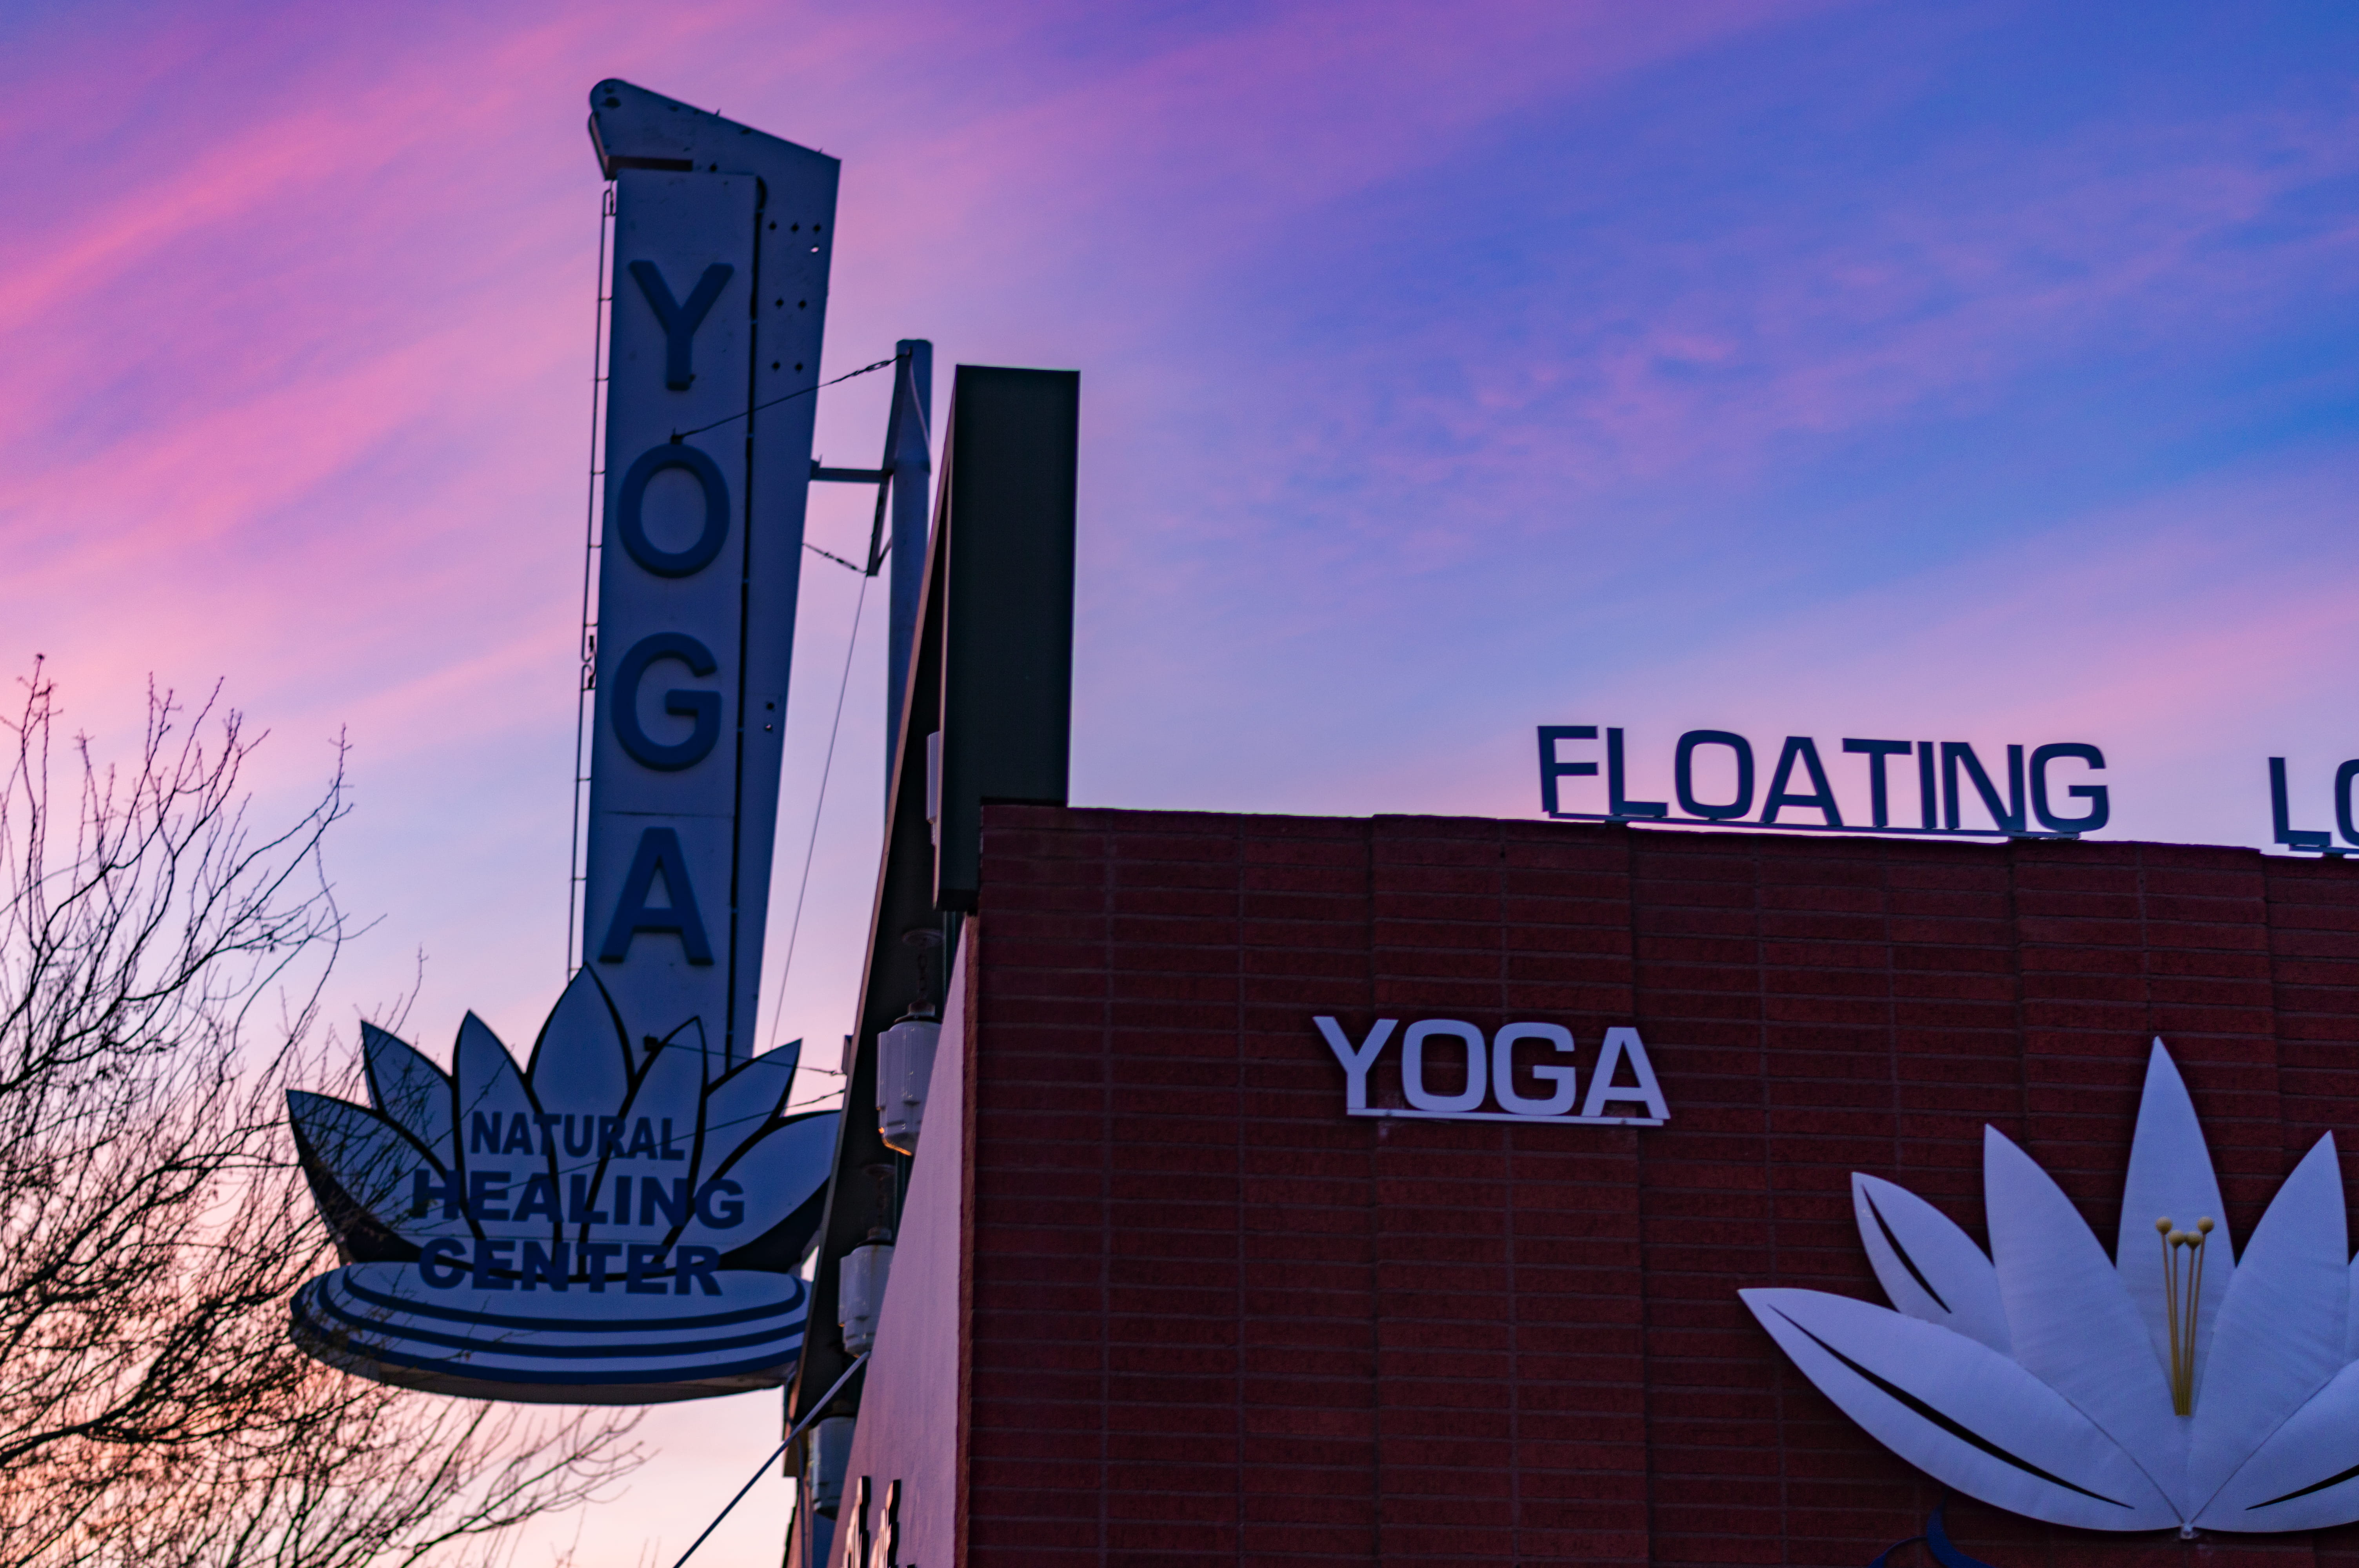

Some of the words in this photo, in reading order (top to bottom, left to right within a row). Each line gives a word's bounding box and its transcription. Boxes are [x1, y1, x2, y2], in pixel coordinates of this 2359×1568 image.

[597, 259, 734, 966] YOGA
[1537, 725, 2110, 833] FLOATING
[1312, 1016, 1671, 1120] YOGA
[471, 1111, 685, 1160] NATURAL
[412, 1169, 745, 1230] HEALING
[419, 1238, 722, 1296] CENTER
